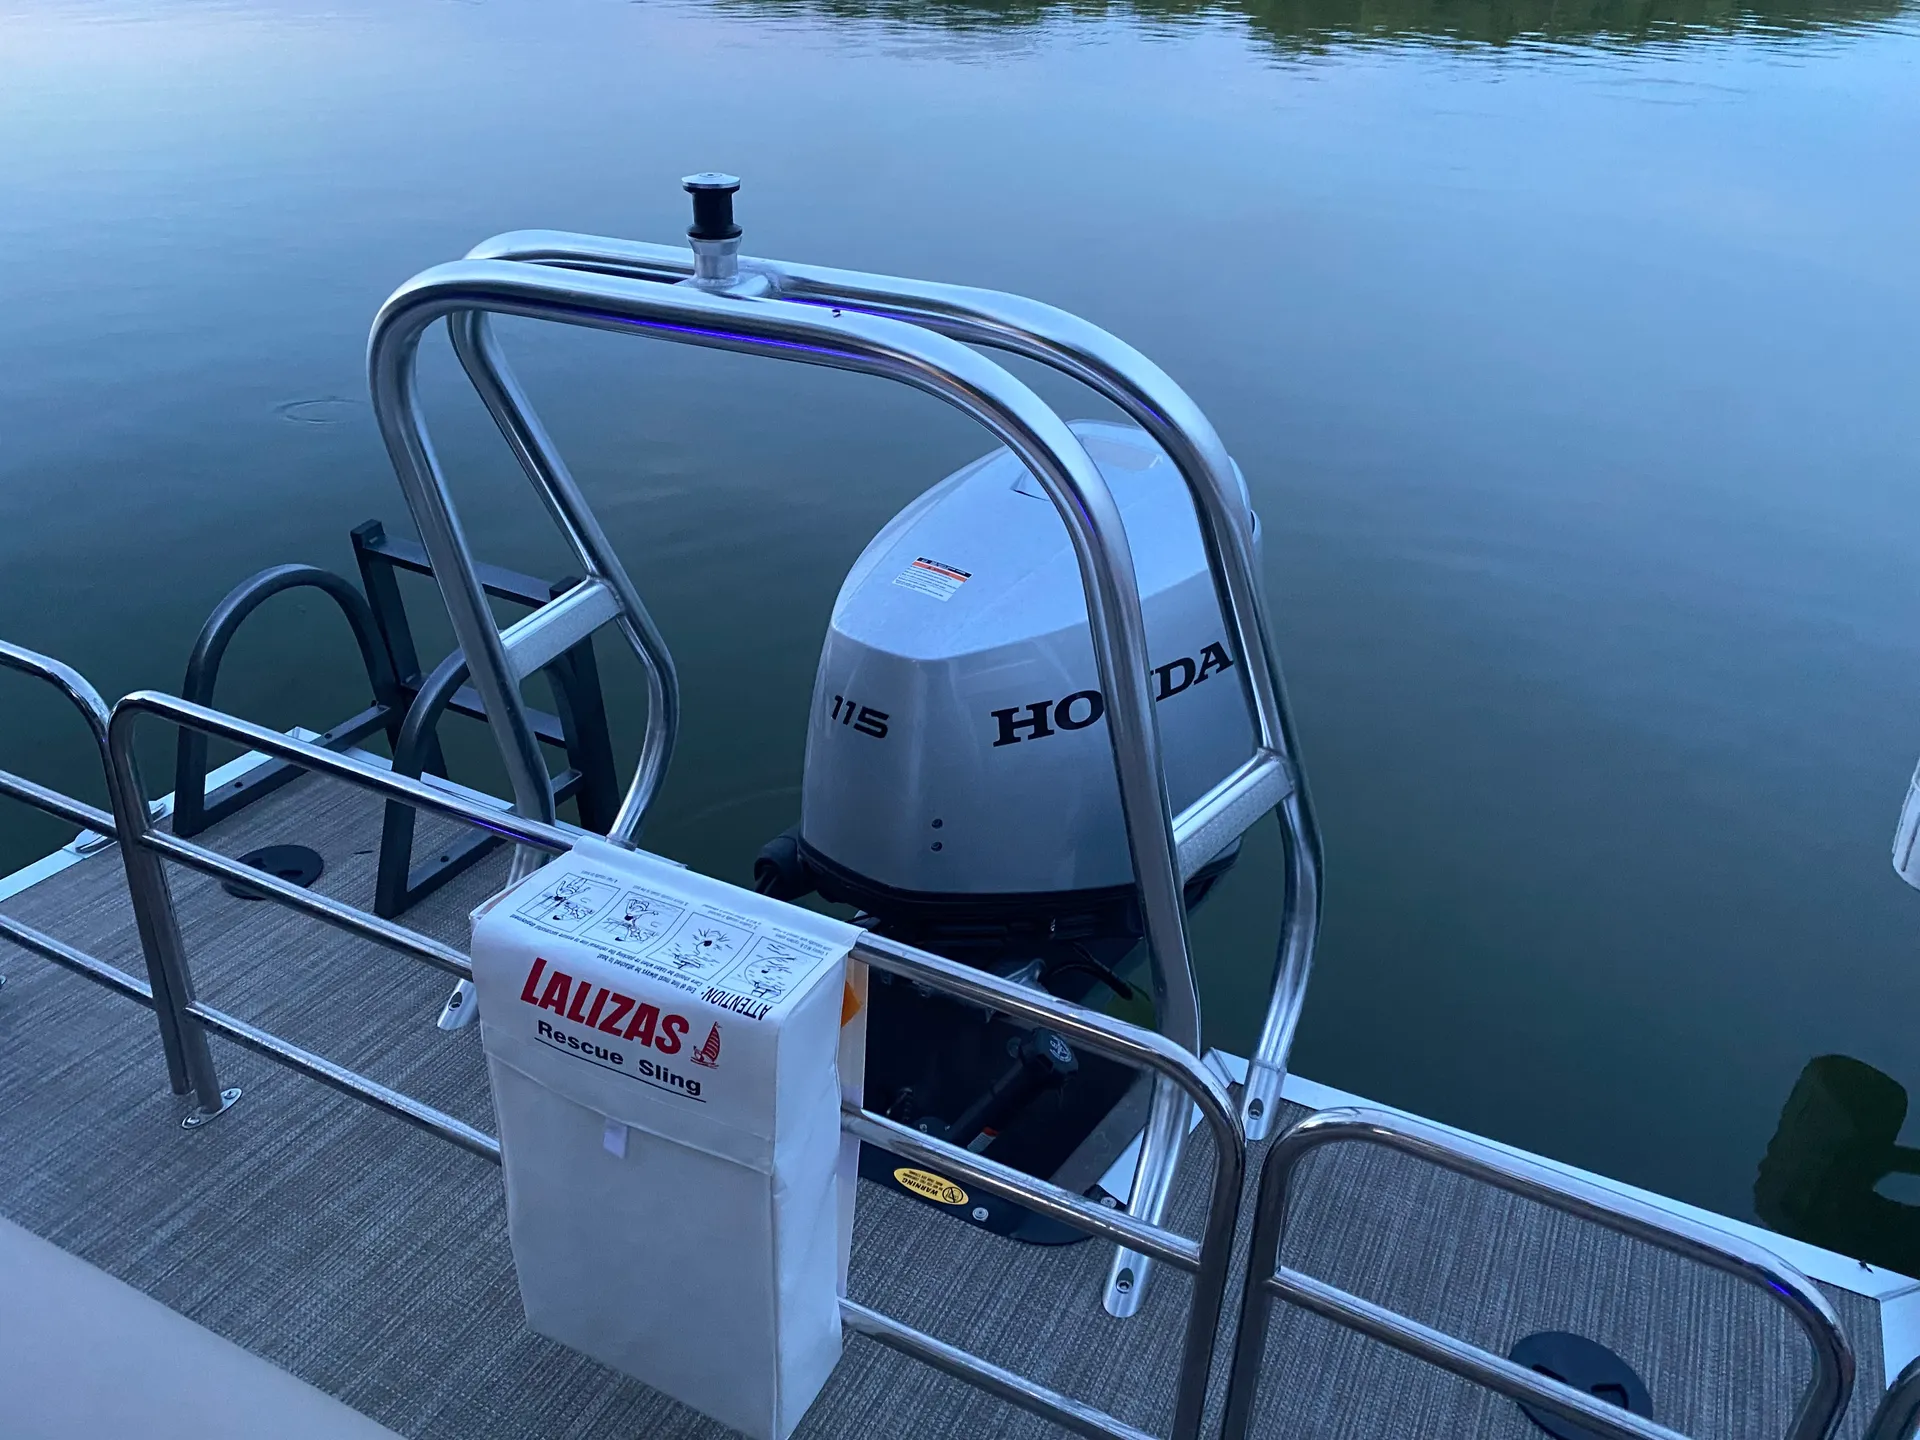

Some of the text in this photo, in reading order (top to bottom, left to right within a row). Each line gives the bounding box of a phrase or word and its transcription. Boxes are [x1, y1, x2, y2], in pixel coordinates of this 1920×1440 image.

[831, 695, 889, 739] 115
[991, 641, 1233, 747] HODA
[520, 957, 690, 1054] LALIZAS
[701, 985, 773, 1021] ATTENTION:
[537, 1020, 701, 1096] Rescue Sling
[902, 1177, 939, 1197] WARNING
